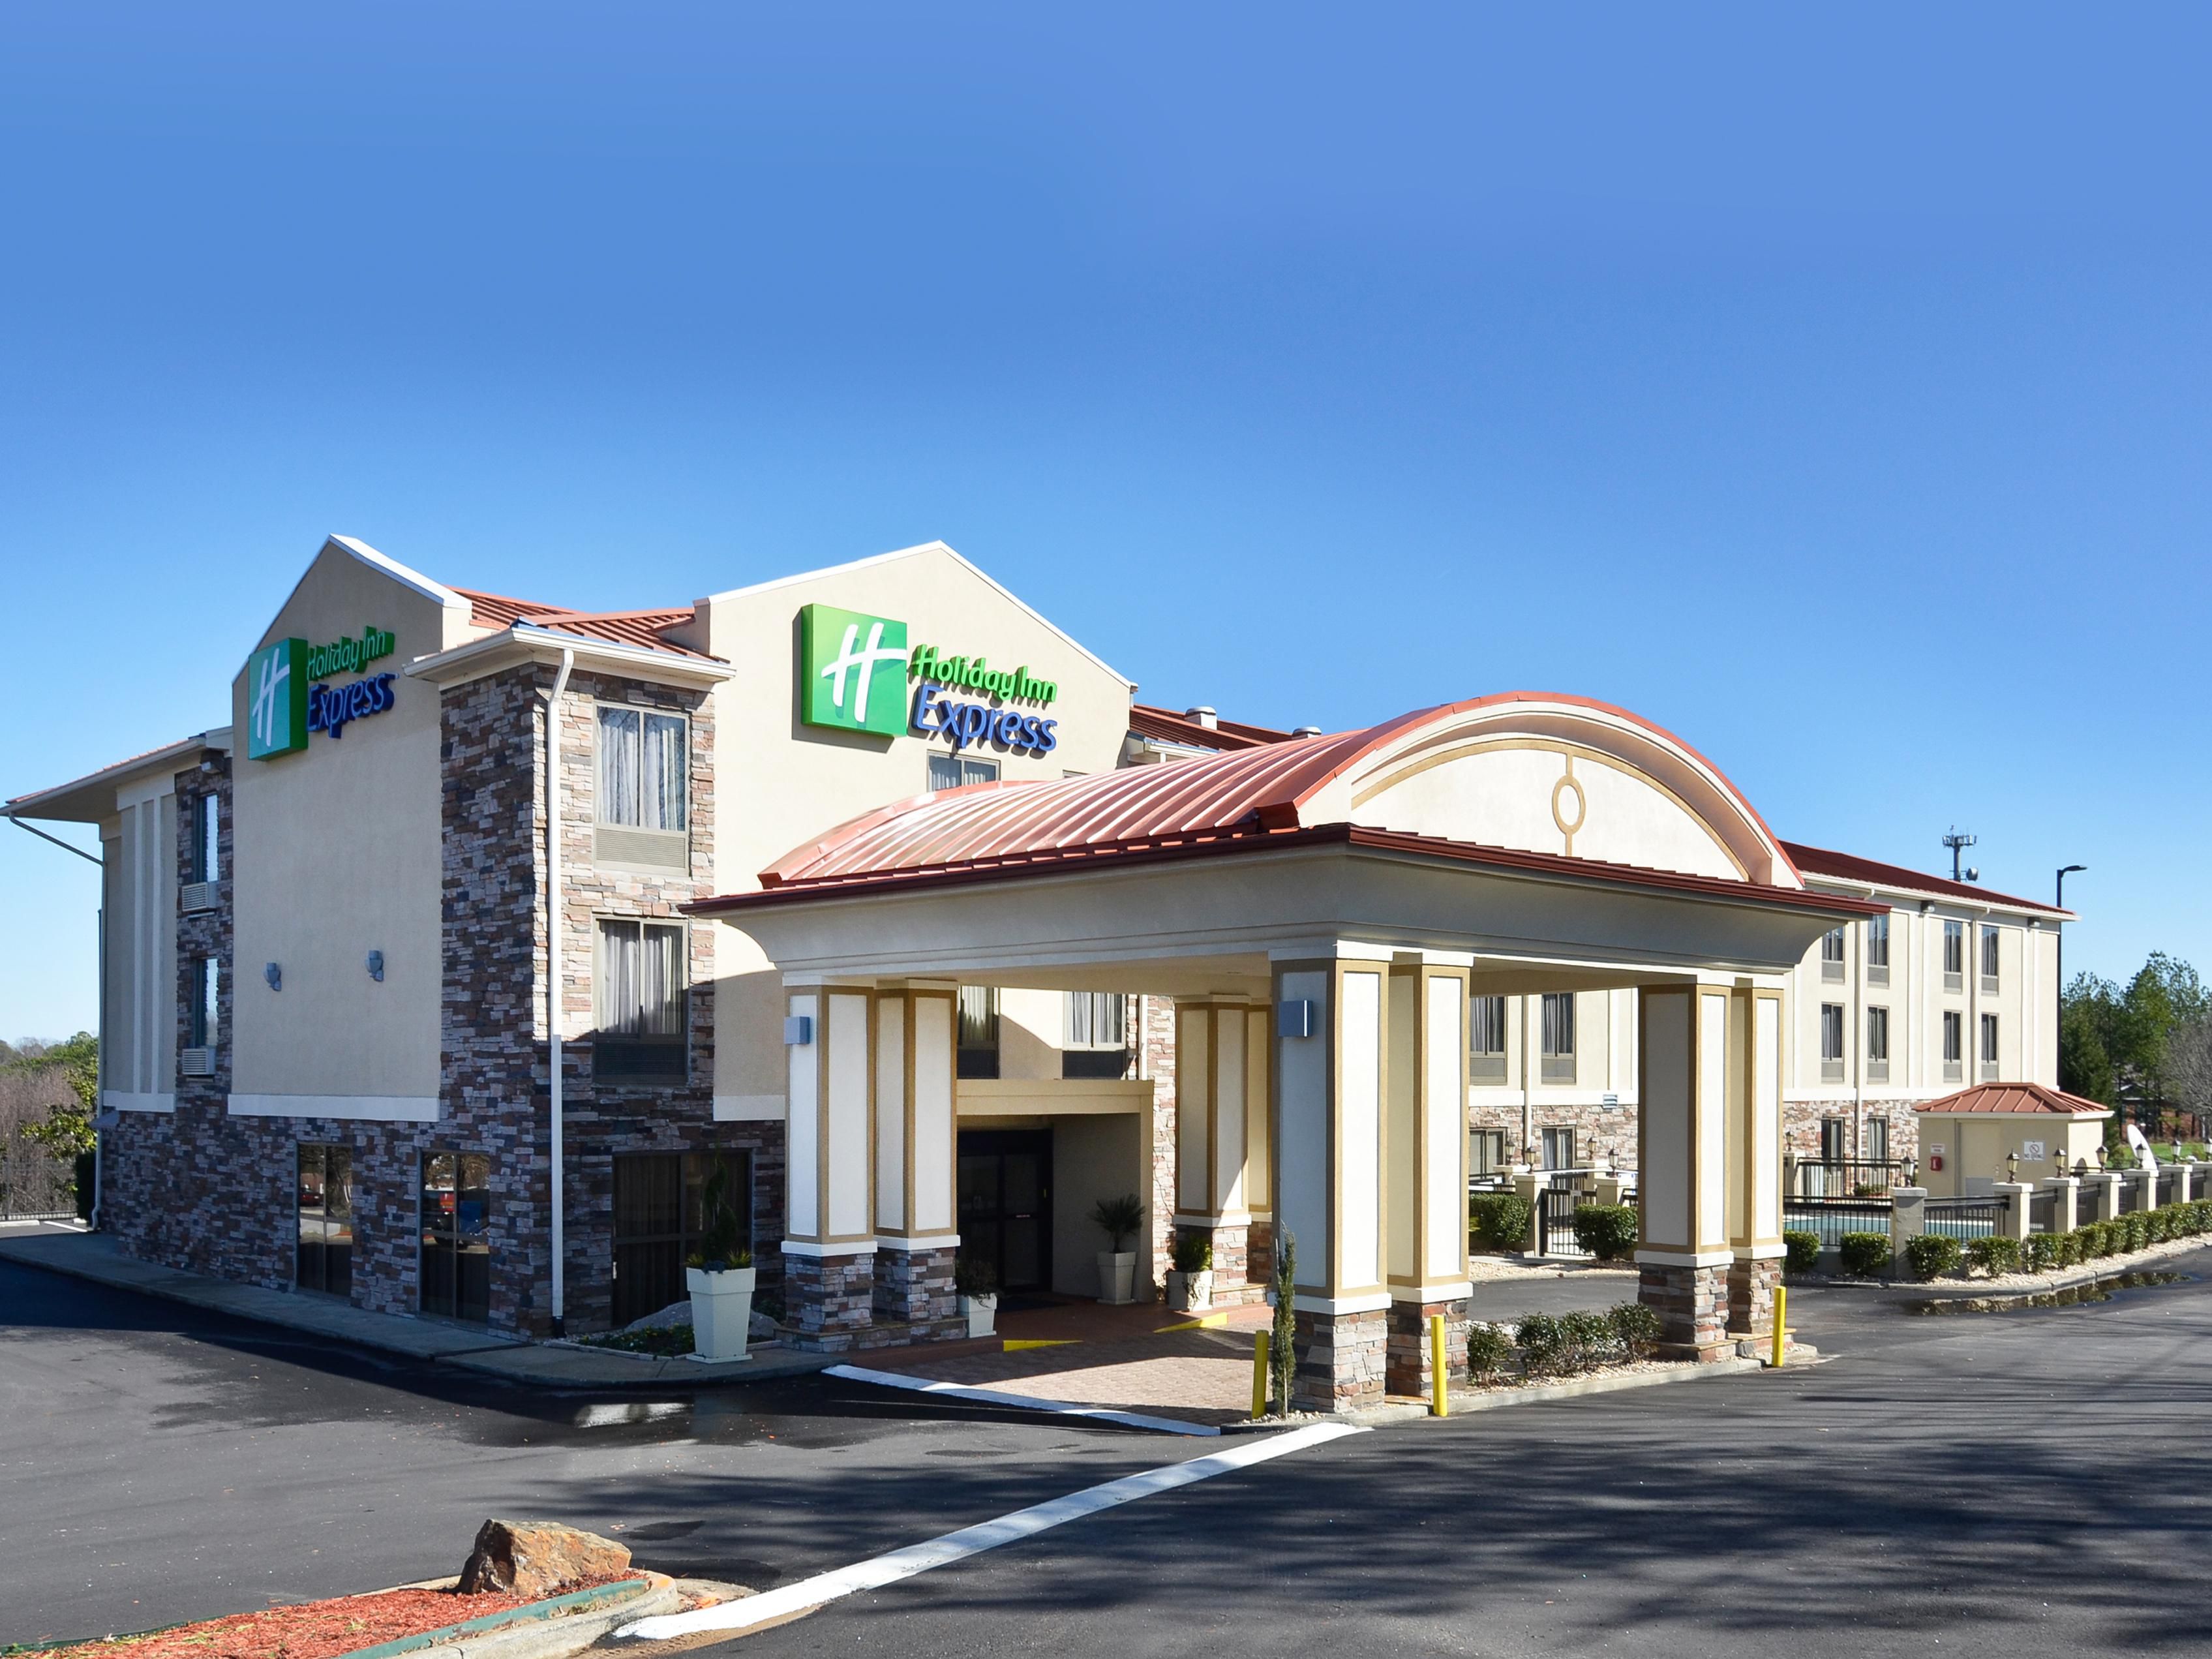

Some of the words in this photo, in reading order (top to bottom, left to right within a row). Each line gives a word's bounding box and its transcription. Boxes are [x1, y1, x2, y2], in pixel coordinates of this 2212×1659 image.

[307, 637, 365, 680] Holiday
[363, 626, 395, 661] Inn
[821, 622, 907, 722] H
[914, 644, 1017, 701] Holiday
[1017, 666, 1057, 703] Inn
[307, 673, 397, 738] Express
[915, 684, 1057, 752] Express
